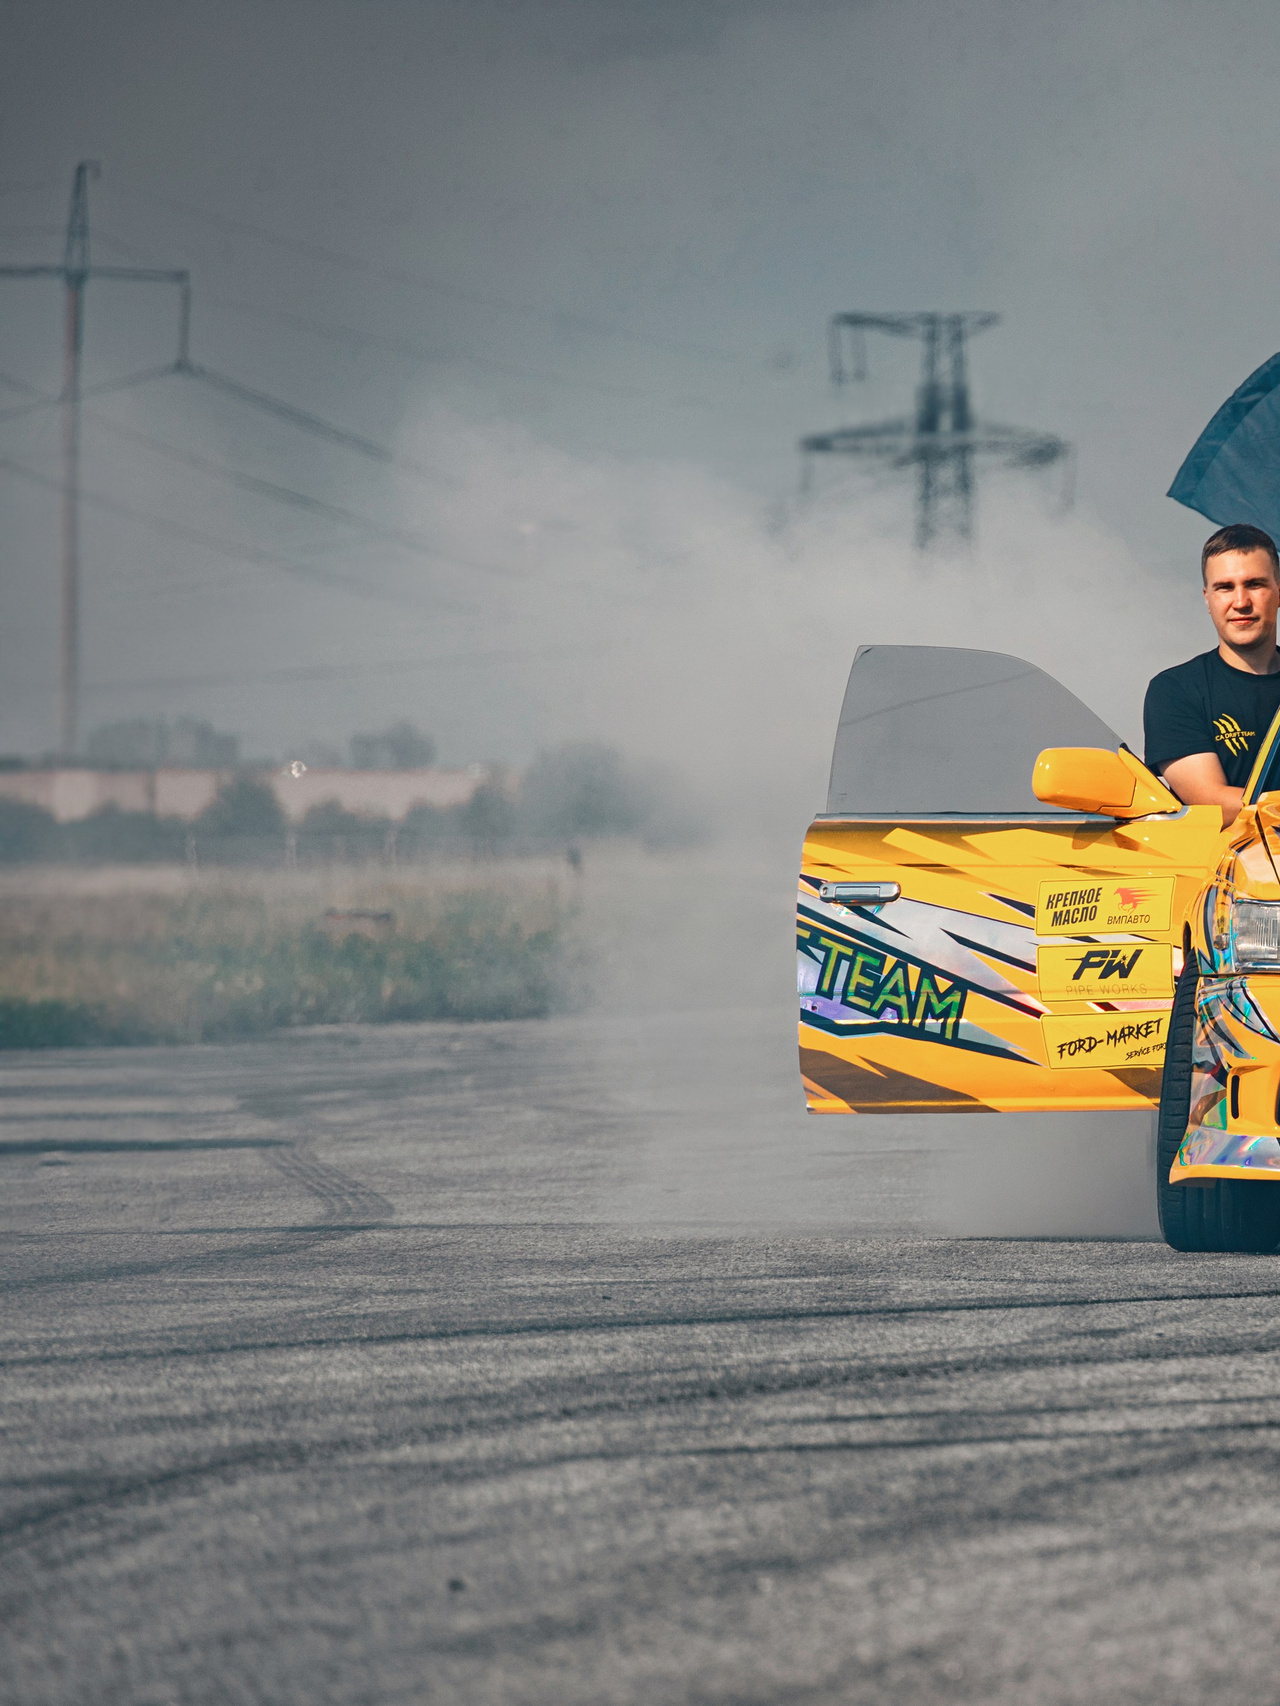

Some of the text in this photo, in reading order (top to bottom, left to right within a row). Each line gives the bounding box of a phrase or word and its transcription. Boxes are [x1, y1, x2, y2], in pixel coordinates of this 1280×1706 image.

[1045, 887, 1103, 910] КРЕПКОЕ
[1051, 905, 1098, 927] МАСЛО
[1106, 914, 1151, 925] ВМПАВТО
[818, 936, 963, 1040] TEAM
[1065, 983, 1148, 996] PIPE WORKS
[1124, 1046, 1151, 1061] SERVICE
